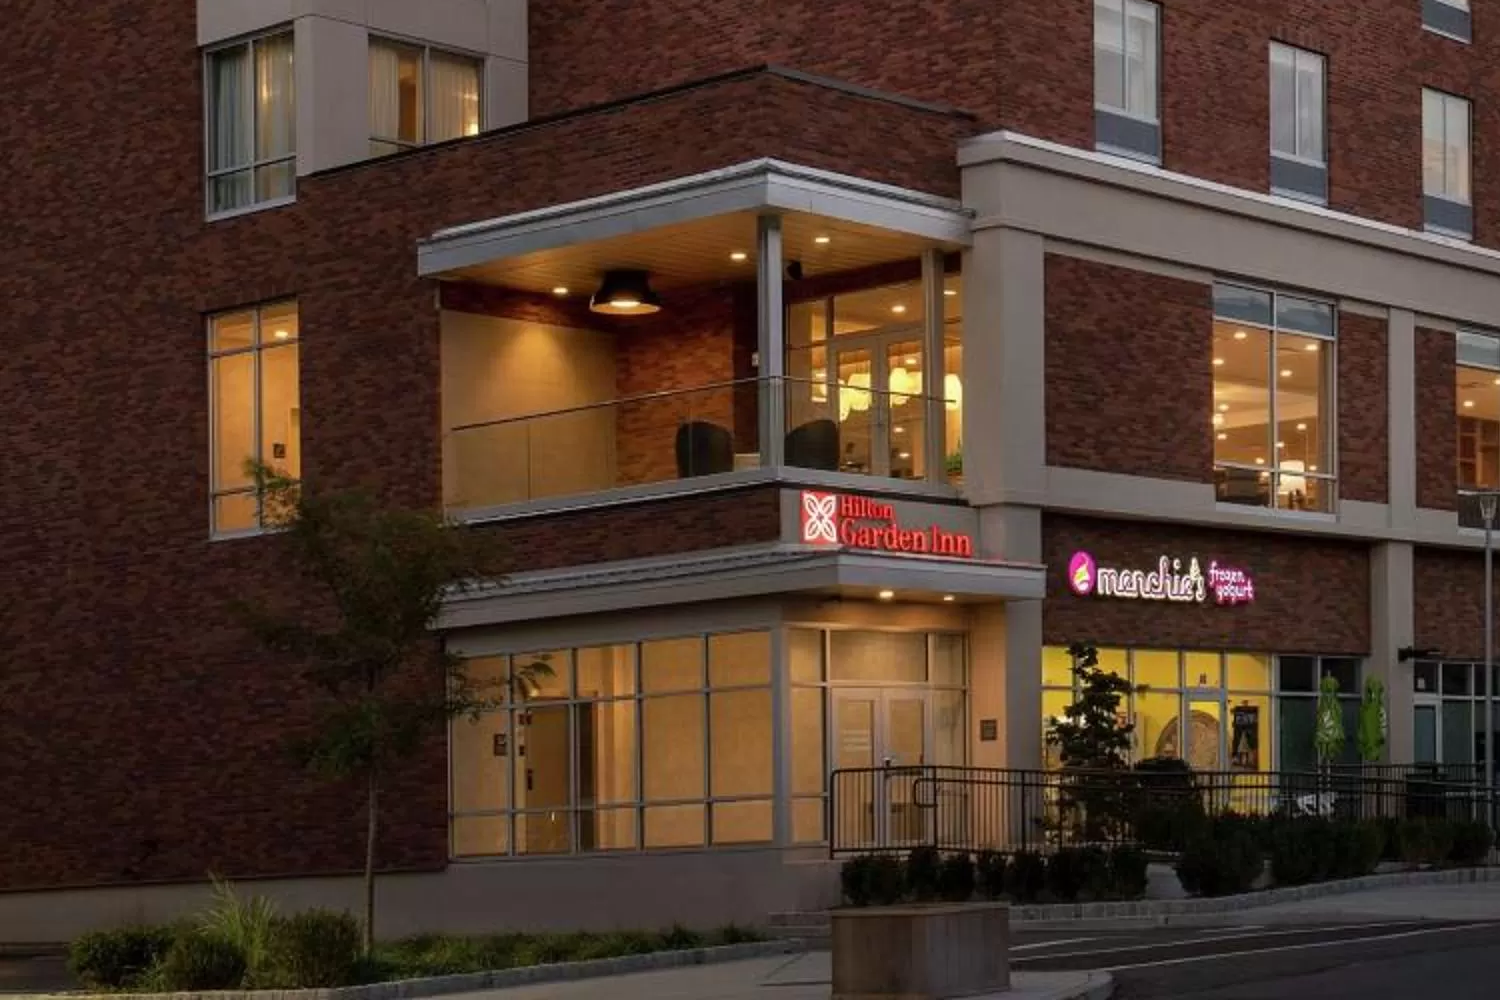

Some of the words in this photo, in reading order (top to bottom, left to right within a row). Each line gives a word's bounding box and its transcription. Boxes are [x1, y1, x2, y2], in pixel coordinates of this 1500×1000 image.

[841, 495, 894, 518] Hilton
[840, 517, 928, 551] Garden
[930, 523, 973, 557] Inn
[1208, 560, 1245, 586] frozen
[1214, 579, 1255, 604] yogurt
